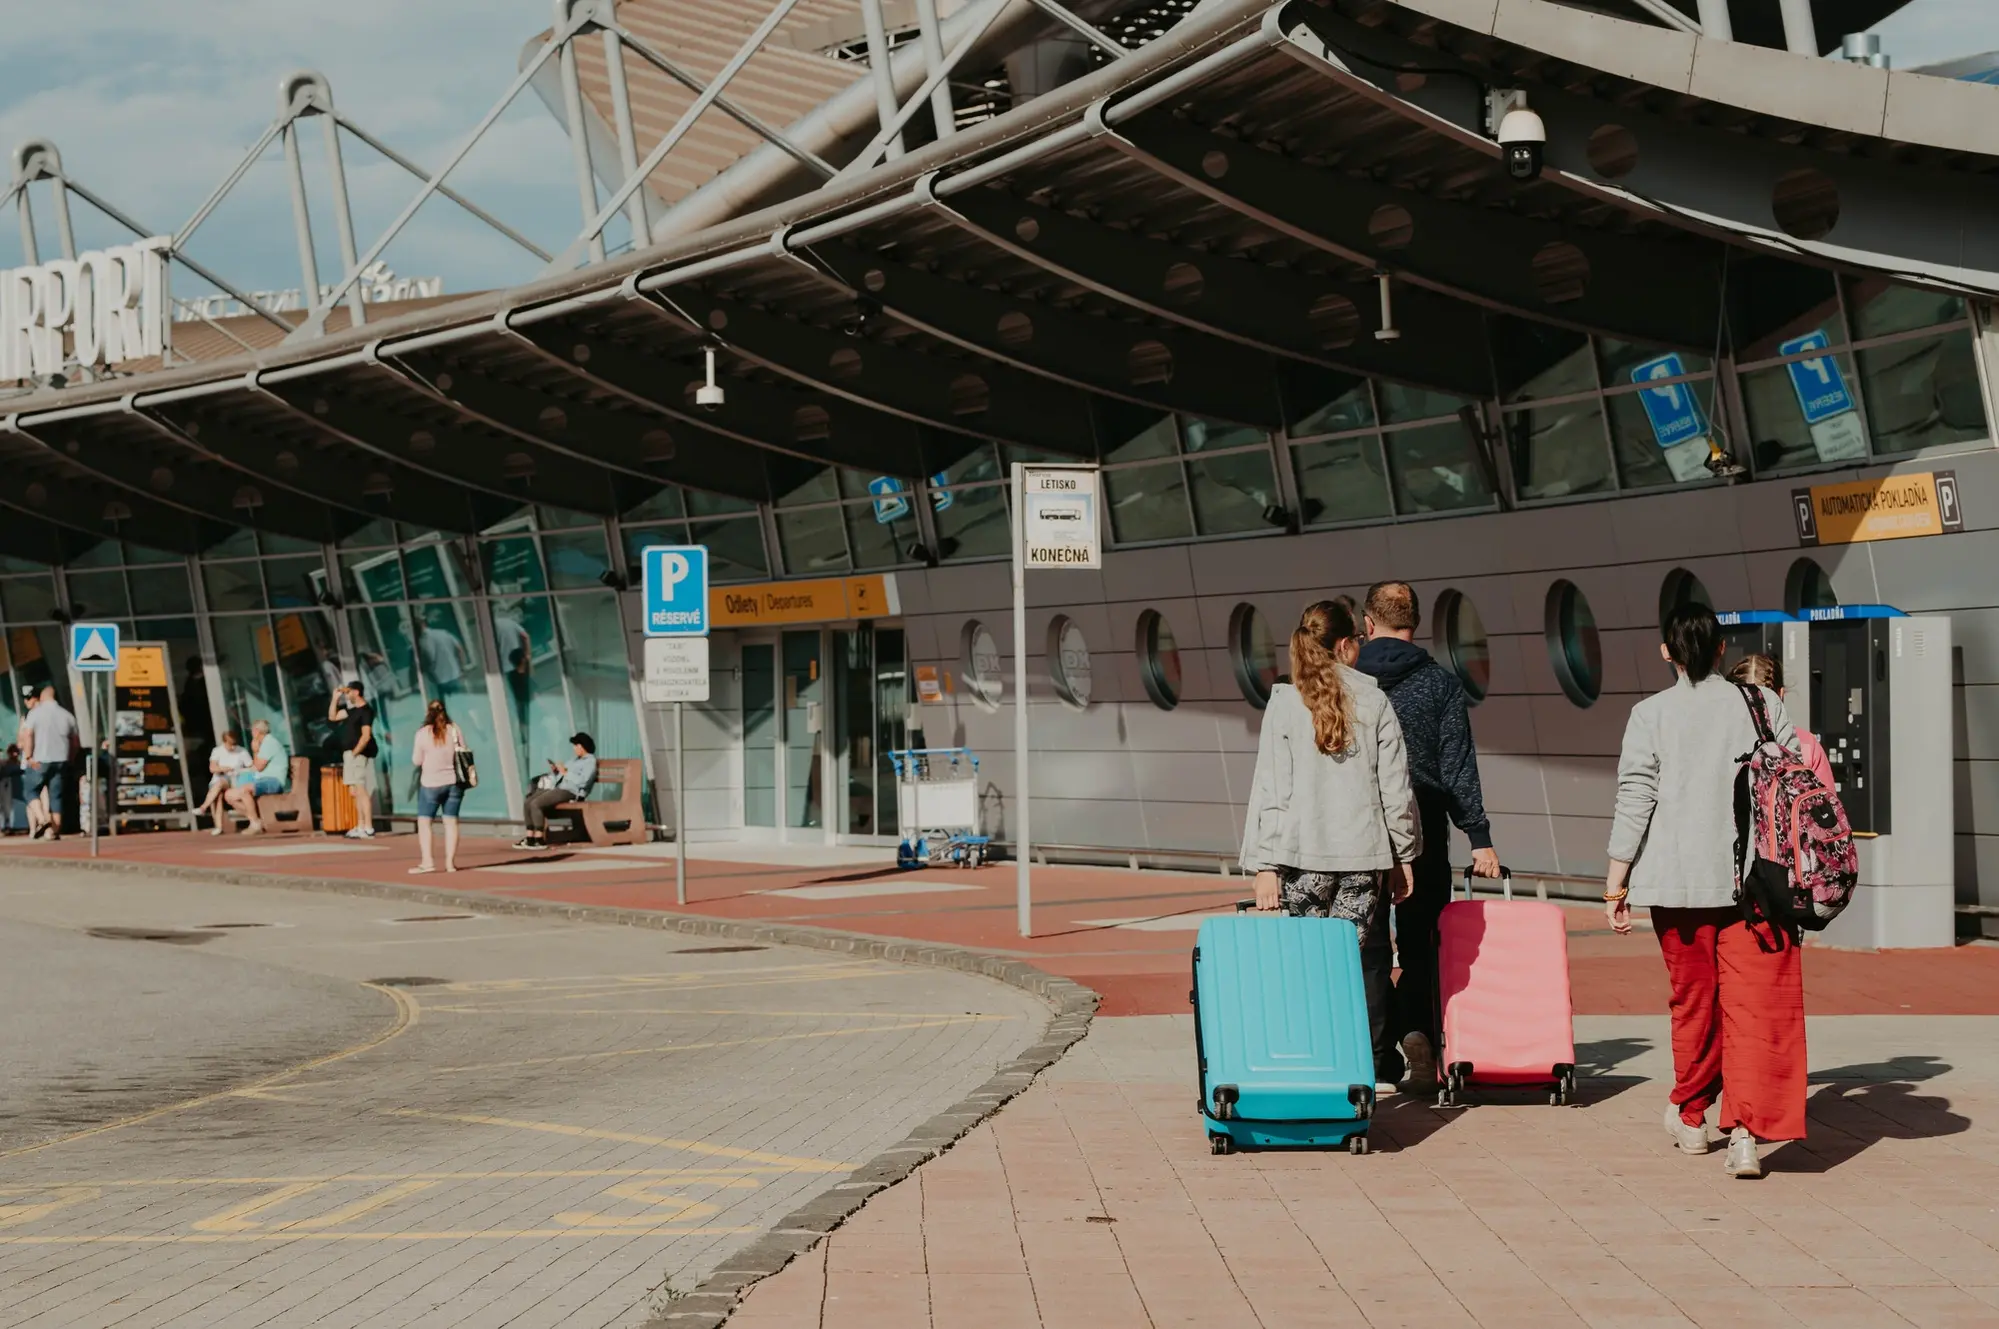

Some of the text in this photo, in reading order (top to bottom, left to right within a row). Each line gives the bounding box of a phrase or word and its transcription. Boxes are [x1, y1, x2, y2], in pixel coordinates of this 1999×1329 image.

[1041, 480, 1076, 490] LETISKO
[1799, 483, 1953, 531] P AUTOMATICKÁ POKLADŇA P
[1031, 545, 1090, 562] KONEČNÁ
[661, 553, 689, 602] P
[725, 594, 758, 617] Odlety
[767, 593, 813, 611] Departures
[1810, 606, 1845, 620] POKLADŇA
[652, 609, 701, 625] RÉSERVÉ
[1716, 611, 1740, 625] KLADŇA
